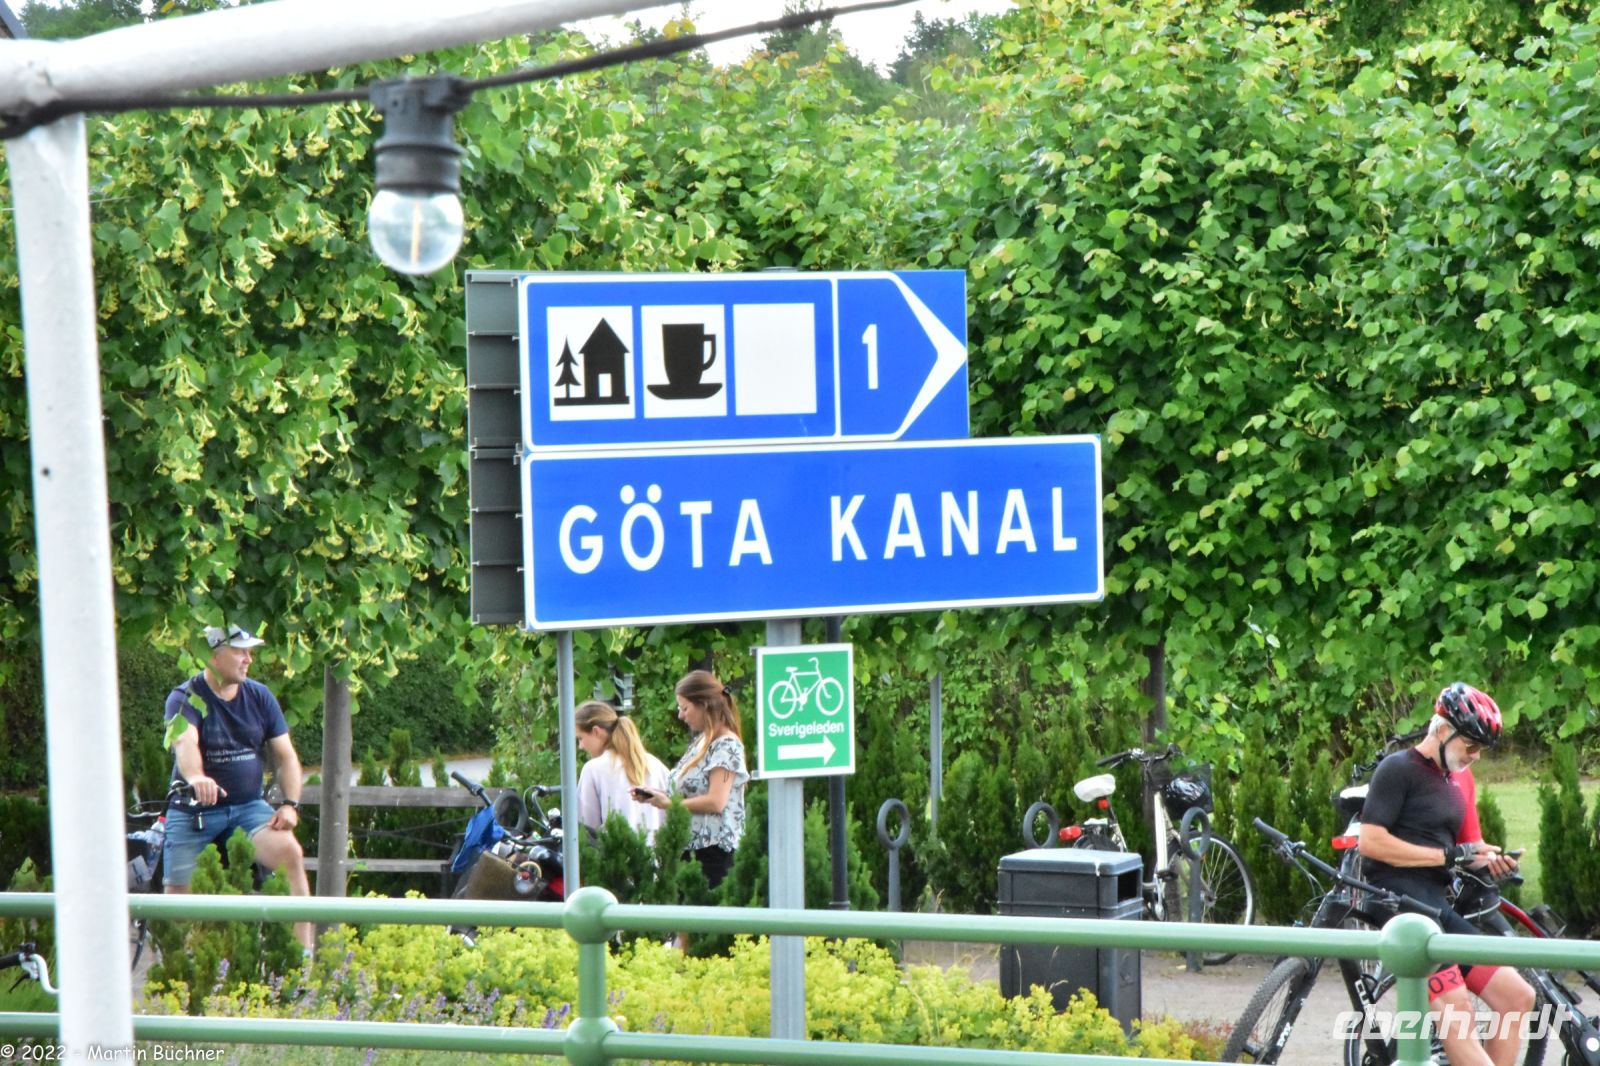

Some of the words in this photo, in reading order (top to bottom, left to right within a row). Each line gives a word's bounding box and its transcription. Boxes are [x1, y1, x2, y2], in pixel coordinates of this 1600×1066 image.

[862, 323, 879, 390] 1
[558, 483, 773, 575] GÖTA
[830, 486, 1078, 562] KANAL
[768, 720, 844, 739] Sverigeleden
